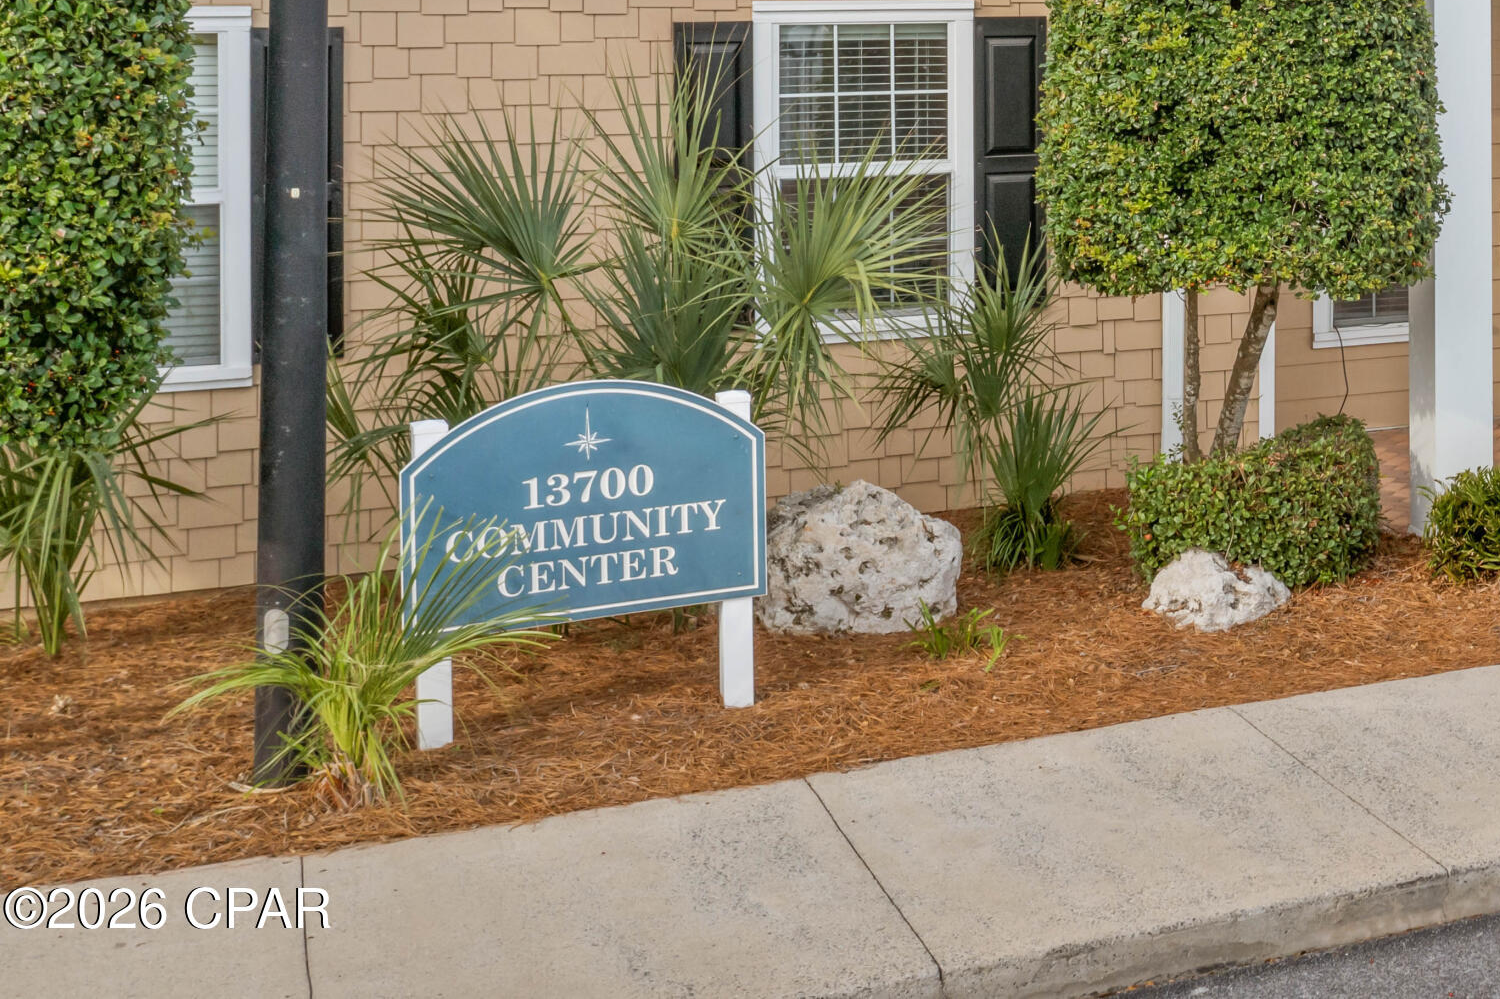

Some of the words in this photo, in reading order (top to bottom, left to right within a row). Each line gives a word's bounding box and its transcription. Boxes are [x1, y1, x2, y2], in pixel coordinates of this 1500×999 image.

[522, 464, 654, 510] 13700
[446, 499, 727, 563] COMMUNITY
[497, 546, 679, 598] CENTER
